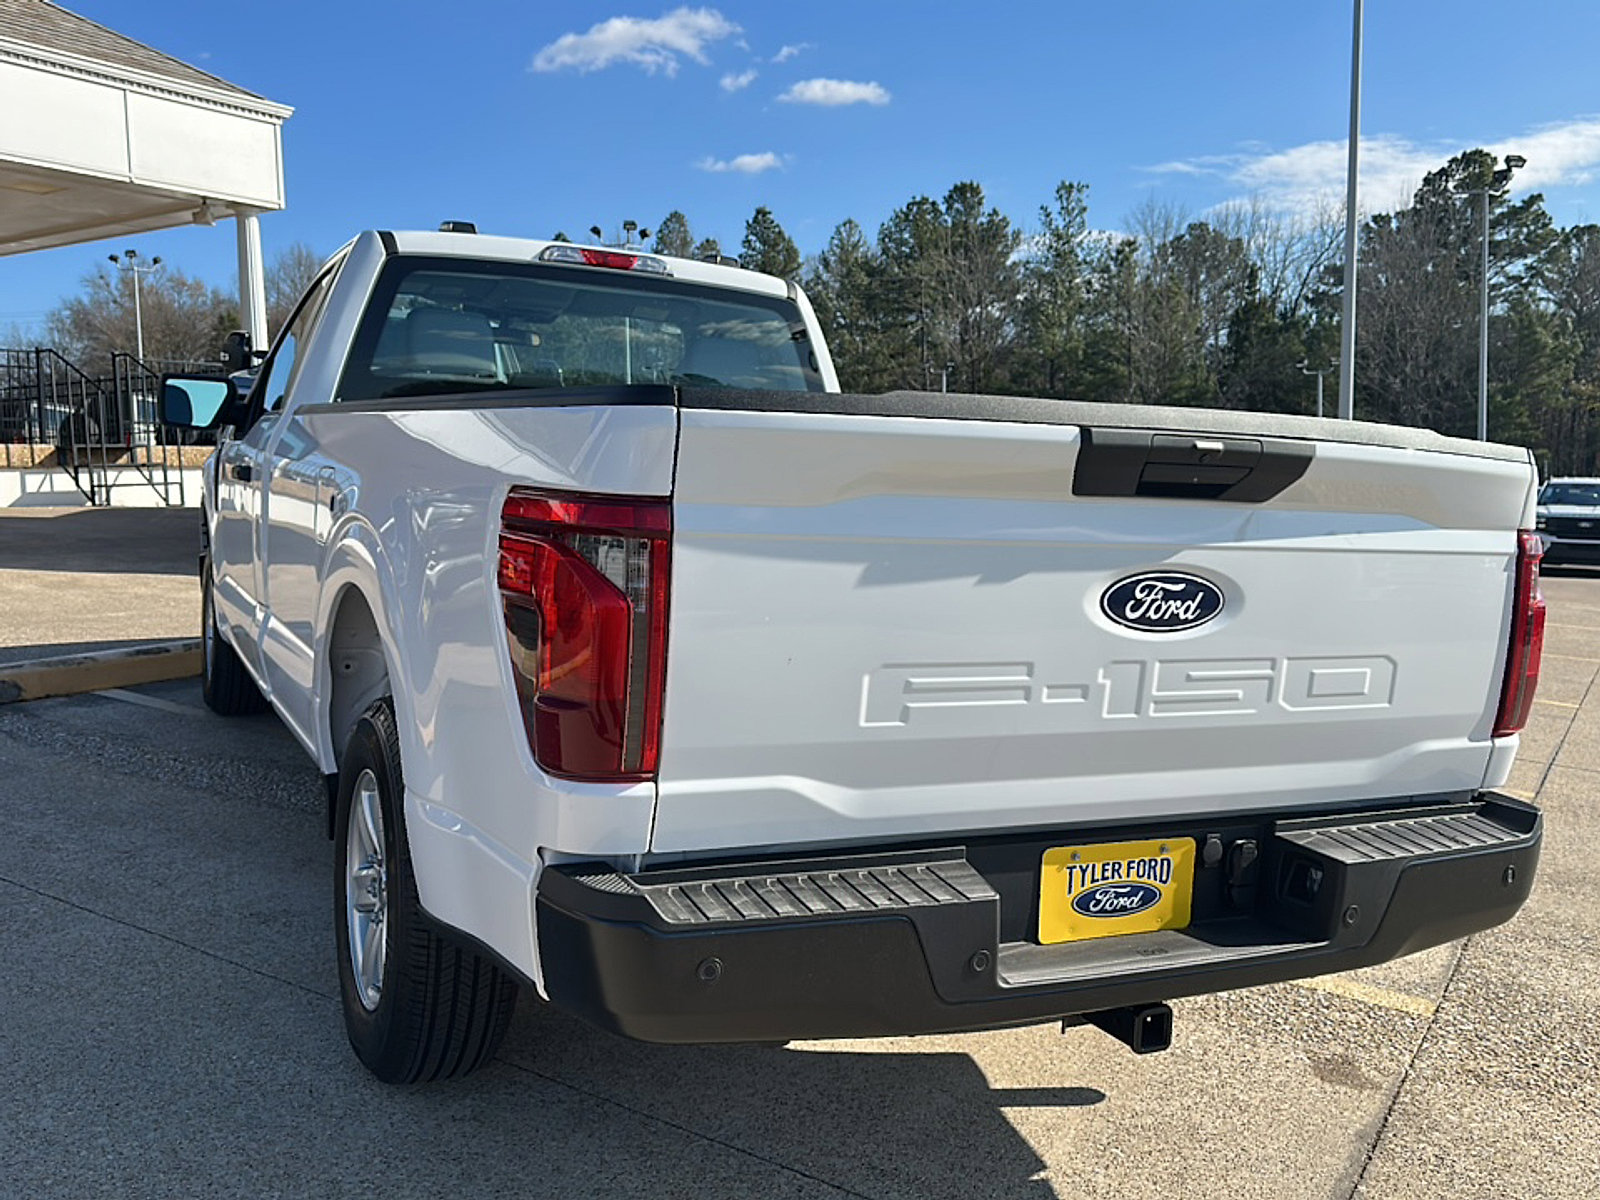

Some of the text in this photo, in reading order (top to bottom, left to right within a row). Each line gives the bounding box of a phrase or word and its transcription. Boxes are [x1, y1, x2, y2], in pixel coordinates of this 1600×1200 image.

[1125, 580, 1204, 620] Ford
[859, 654, 1397, 727] F-150
[1065, 857, 1172, 897] TYLER FORD
[1089, 886, 1145, 912] Ford
